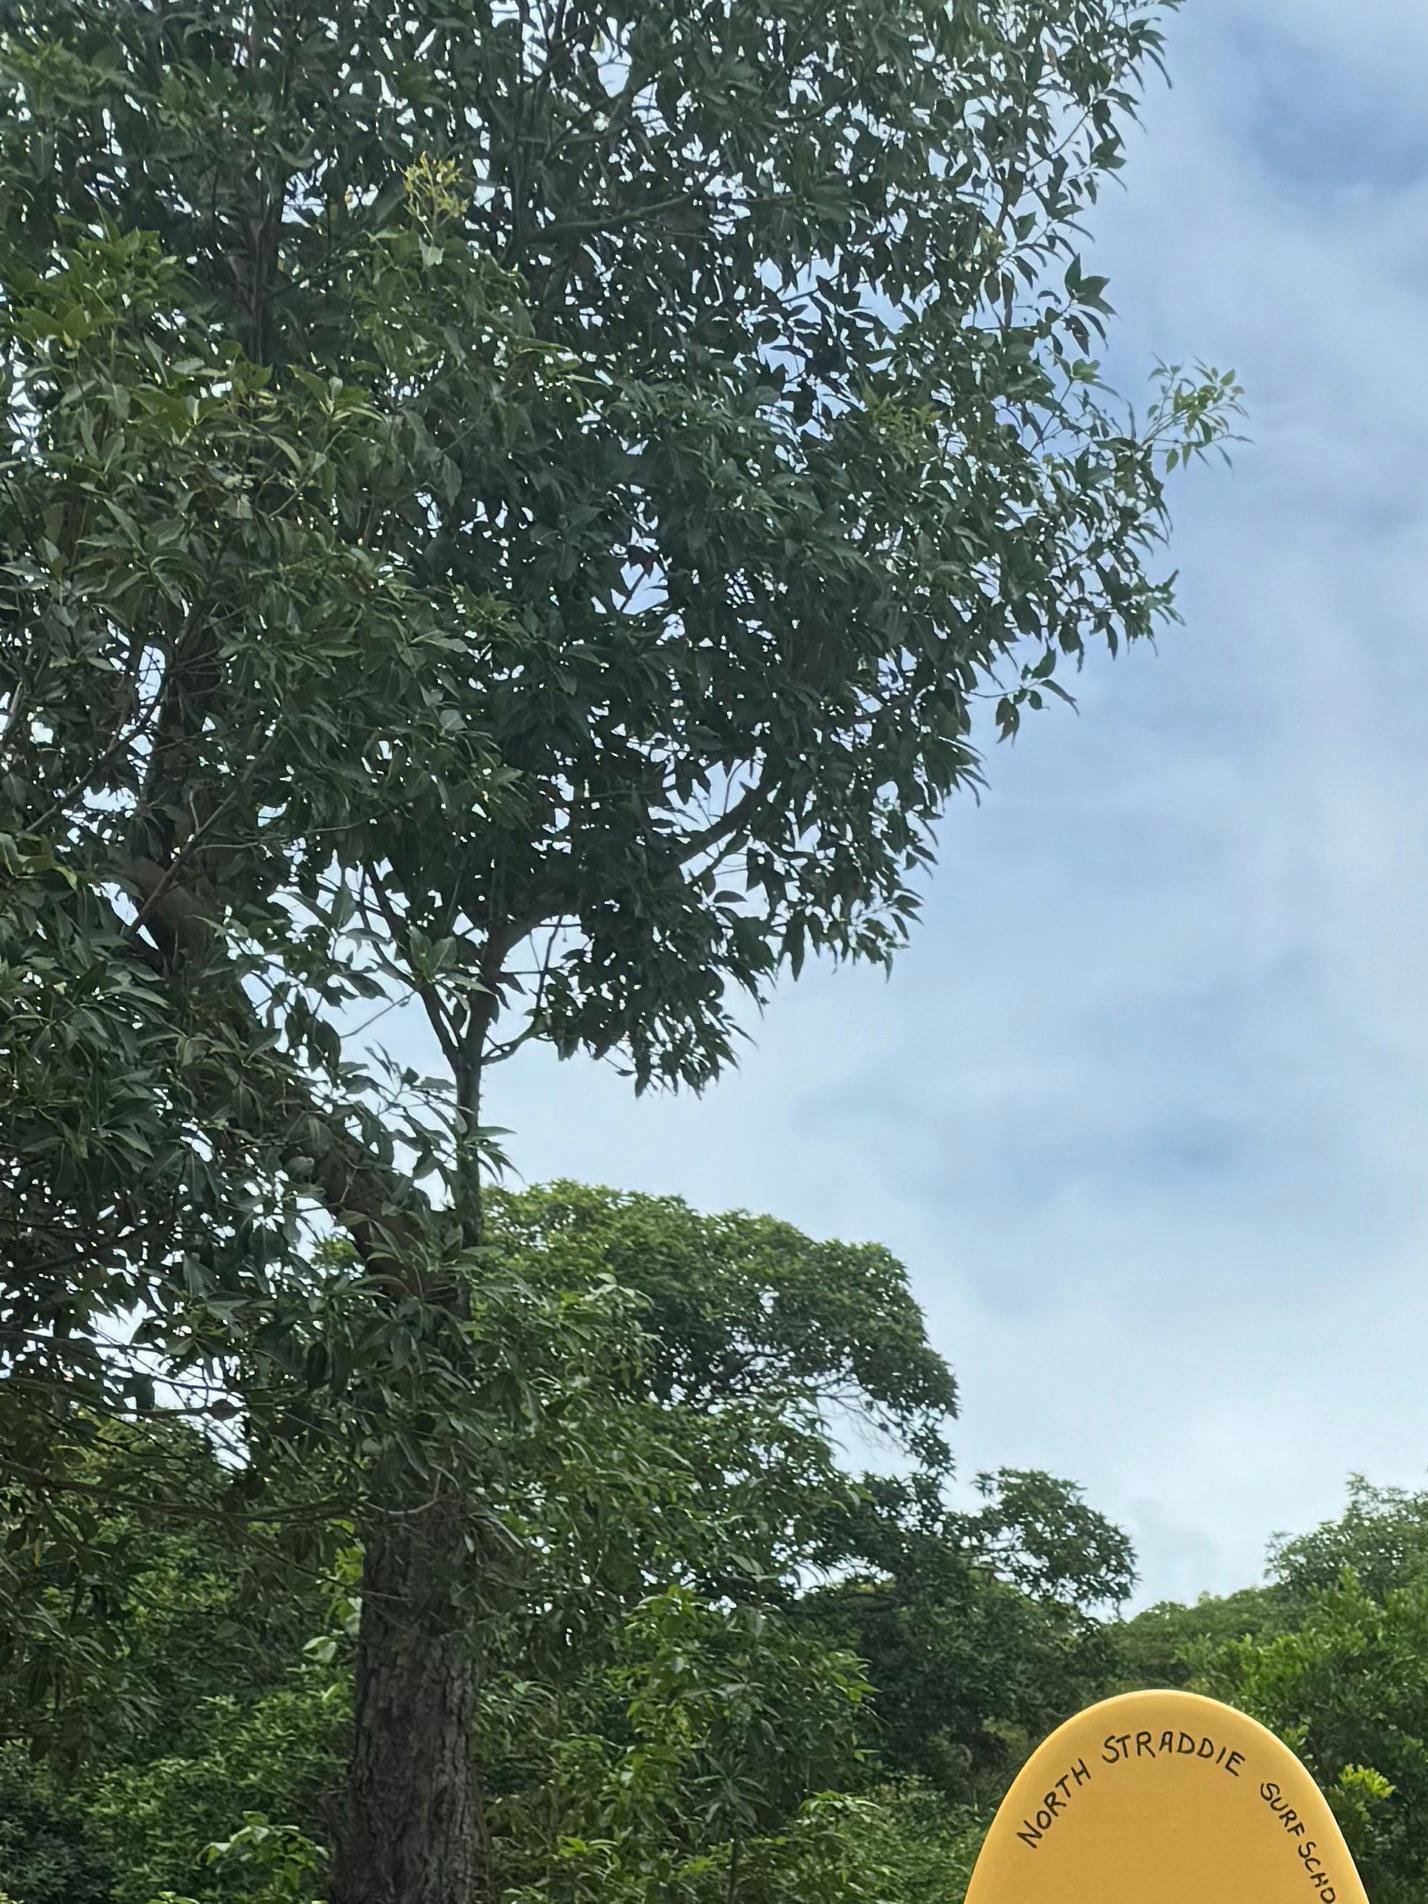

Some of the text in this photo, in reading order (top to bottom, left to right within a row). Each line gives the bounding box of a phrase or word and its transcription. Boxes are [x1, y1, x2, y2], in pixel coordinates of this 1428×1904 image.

[1016, 1758, 1091, 1849] NORTH
[1101, 1730, 1246, 1778] STRADDIE
[1259, 1781, 1306, 1838] SURF
